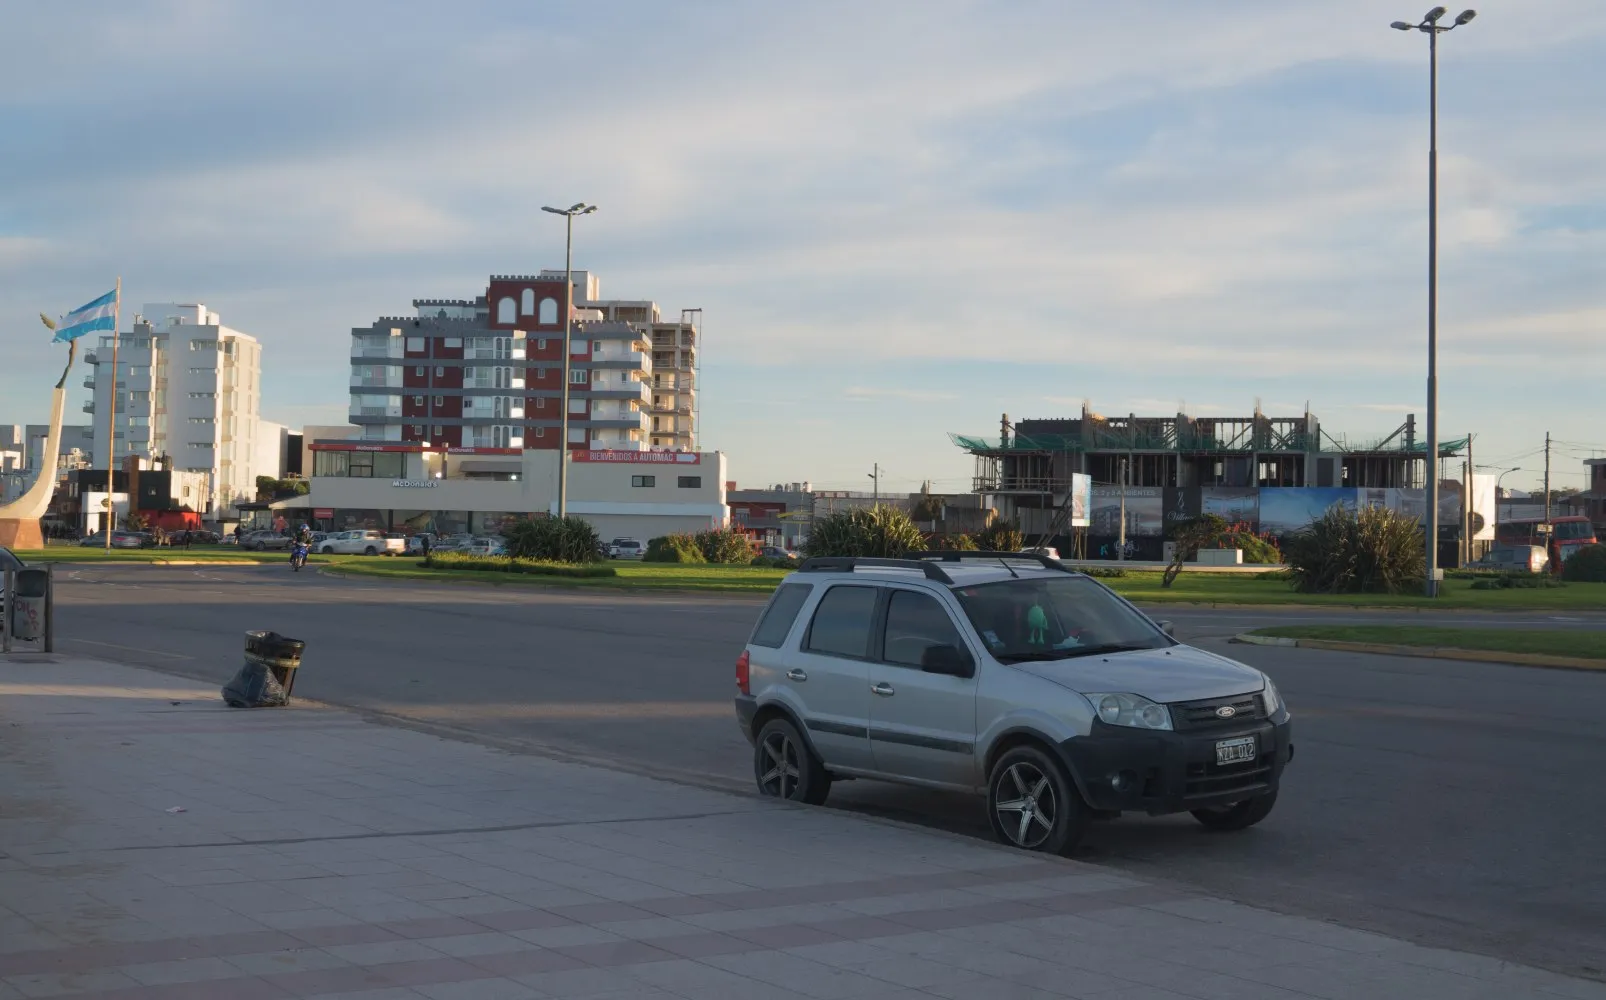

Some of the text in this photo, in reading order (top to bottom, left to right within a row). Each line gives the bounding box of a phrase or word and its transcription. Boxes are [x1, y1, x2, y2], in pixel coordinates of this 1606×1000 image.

[590, 451, 673, 462] BIENVENIDOS A AUTOMAC
[392, 480, 438, 489] McDonald's
[1238, 744, 1254, 758] 012
